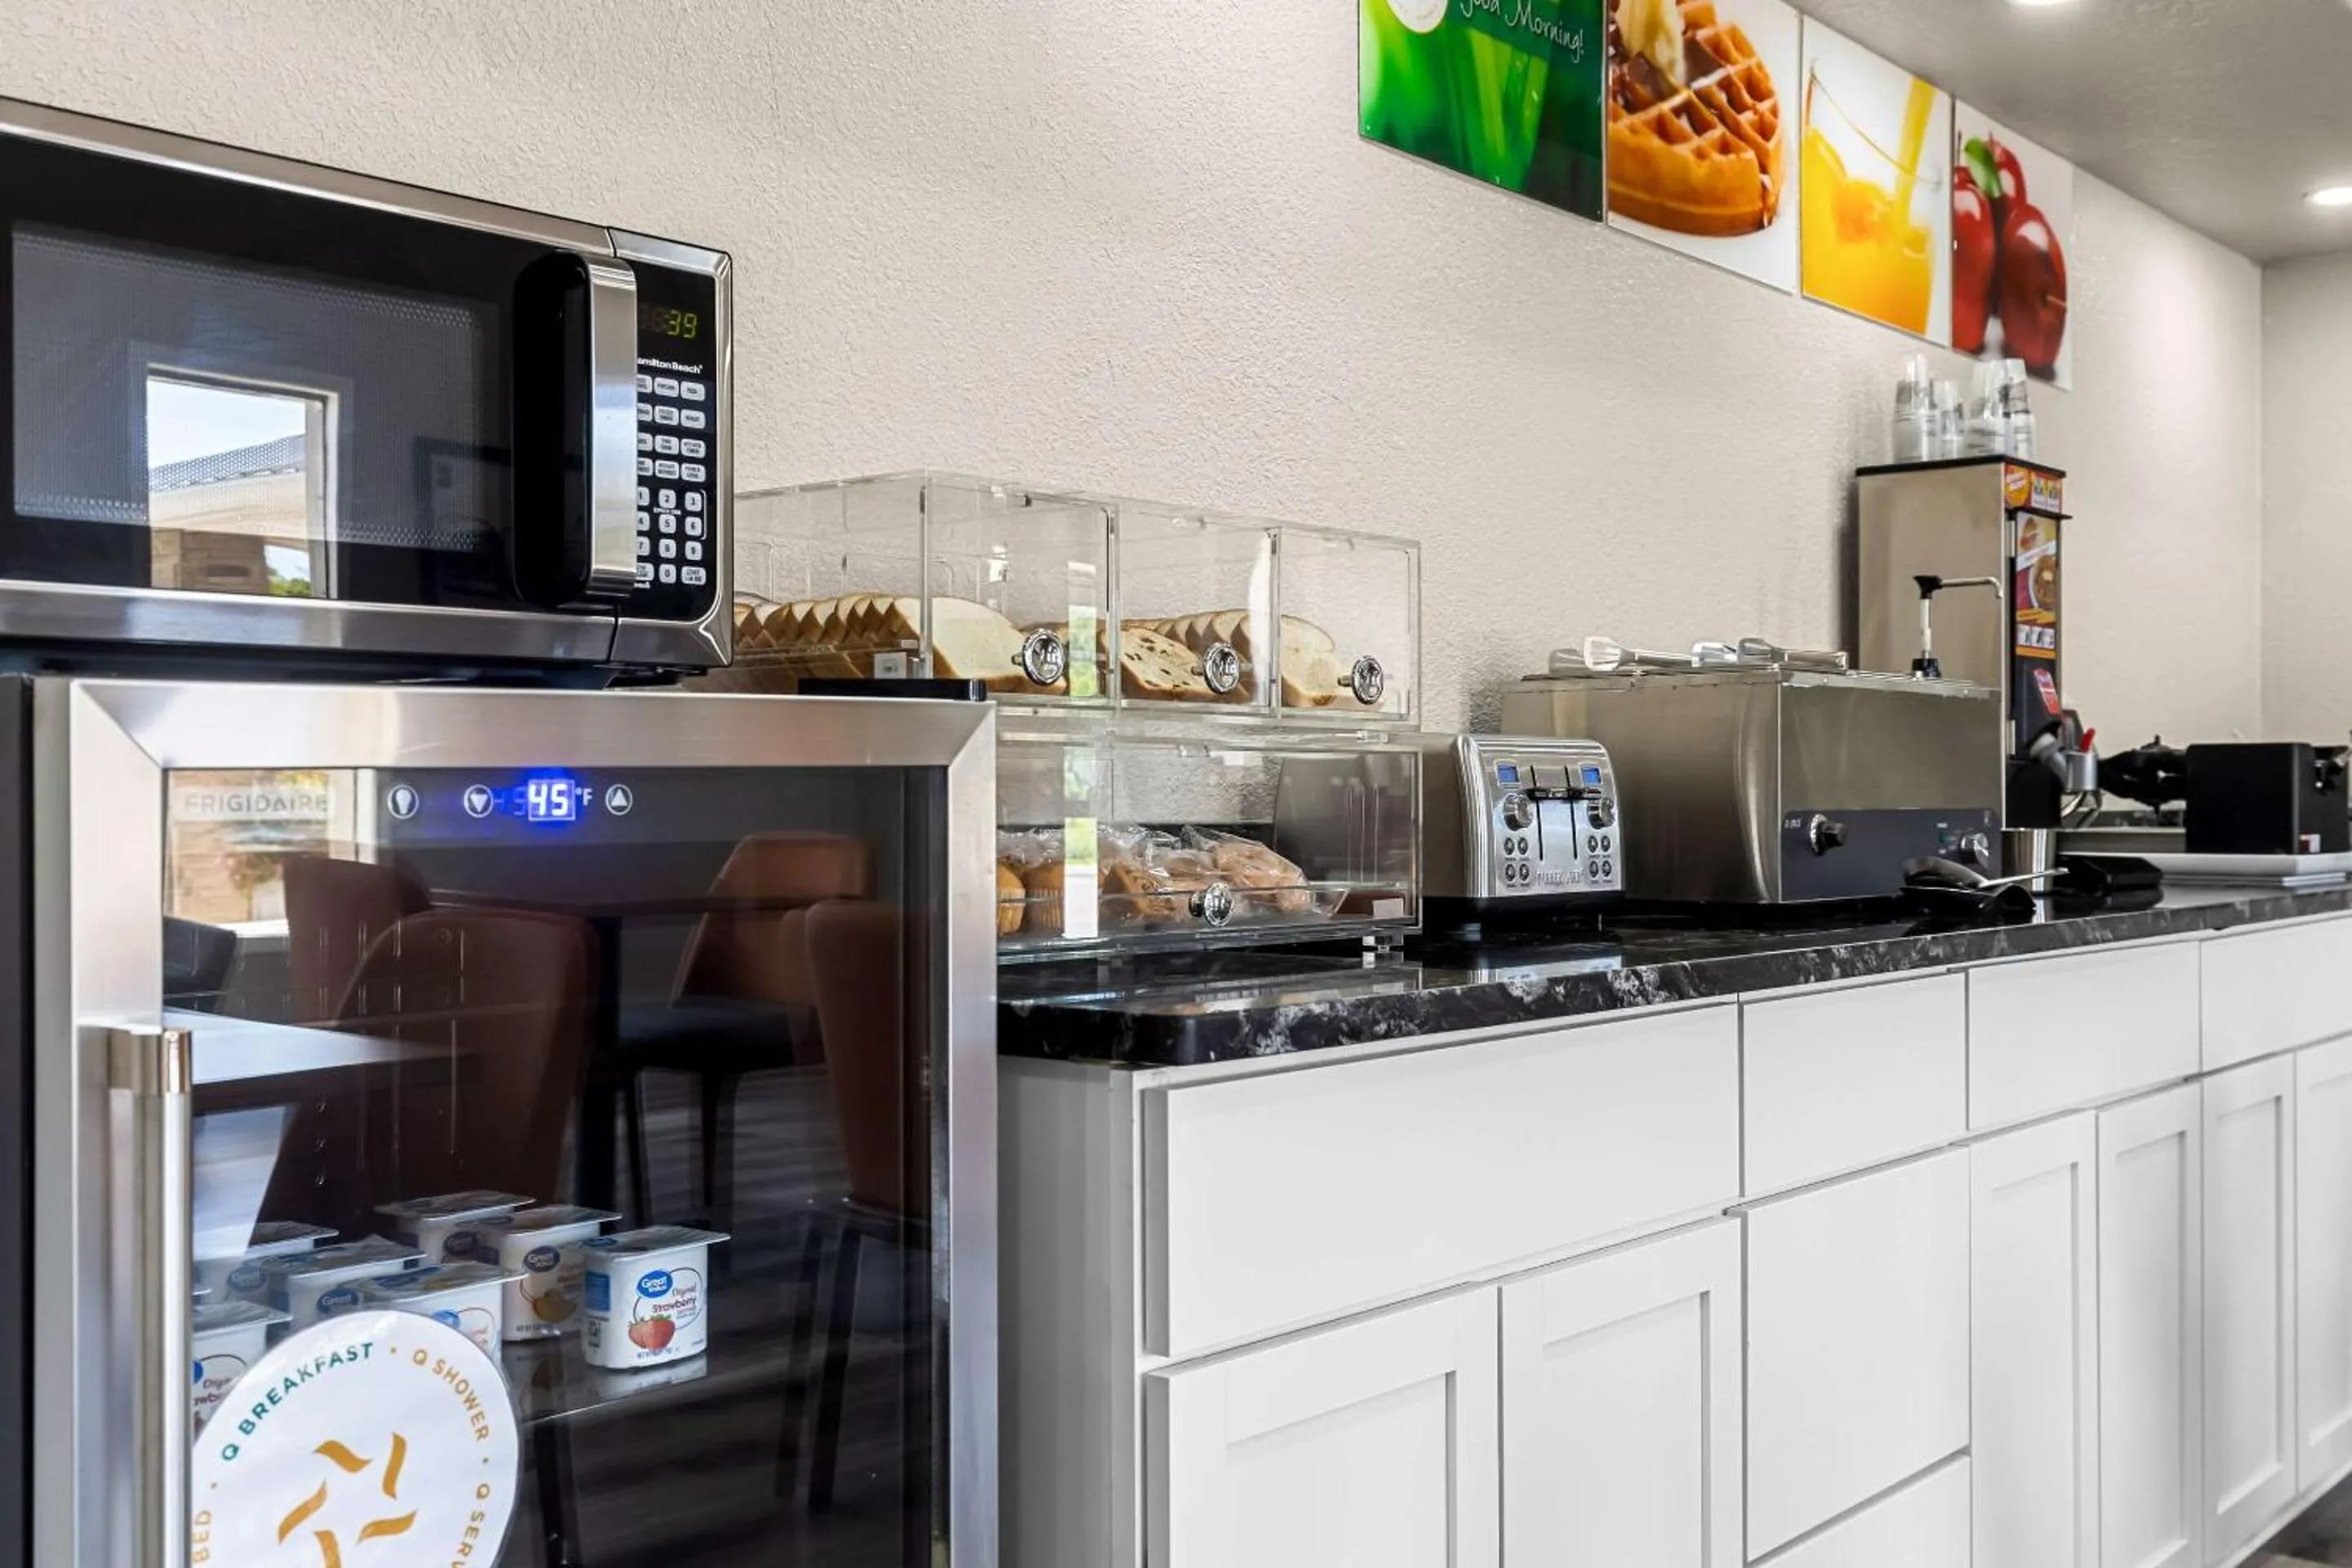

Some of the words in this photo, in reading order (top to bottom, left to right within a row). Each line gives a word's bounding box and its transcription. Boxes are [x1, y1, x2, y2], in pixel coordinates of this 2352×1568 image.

[1504, 0, 1584, 64] Morning!
[637, 358, 671, 369] amilton
[672, 362, 701, 374] Beach
[185, 794, 328, 813] FRIGIDAIRE
[528, 783, 568, 816] 45
[652, 1297, 697, 1313] Strawberry
[221, 1443, 239, 1461] Q
[238, 1342, 373, 1436] BREAKFAST
[412, 1348, 428, 1365] Q
[432, 1358, 489, 1441] SHOWER
[476, 1483, 490, 1500] Q
